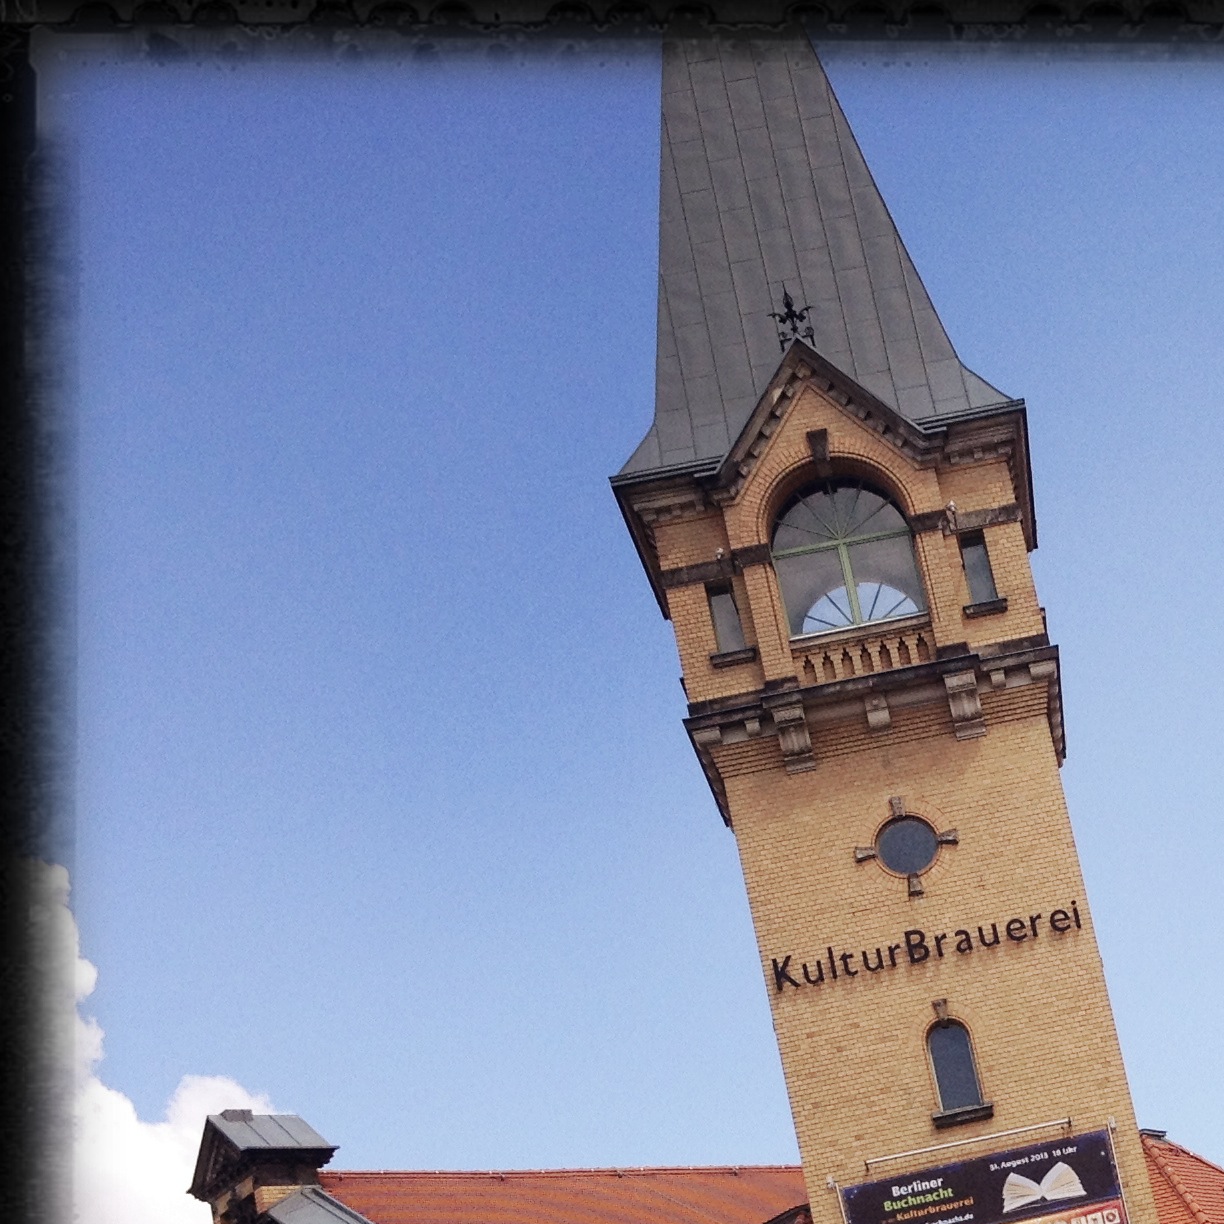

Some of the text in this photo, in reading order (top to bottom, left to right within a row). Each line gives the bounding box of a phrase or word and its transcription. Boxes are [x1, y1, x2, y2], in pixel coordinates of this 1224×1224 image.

[771, 900, 1082, 992] KulturBrauerei
[1001, 1157, 1029, 1170] August
[1062, 1146, 1077, 1155] Uhr
[883, 1187, 954, 1212] Buchnacht
[891, 1178, 943, 1197] Berliner
[896, 1196, 974, 1221] Kulturbrauerei
